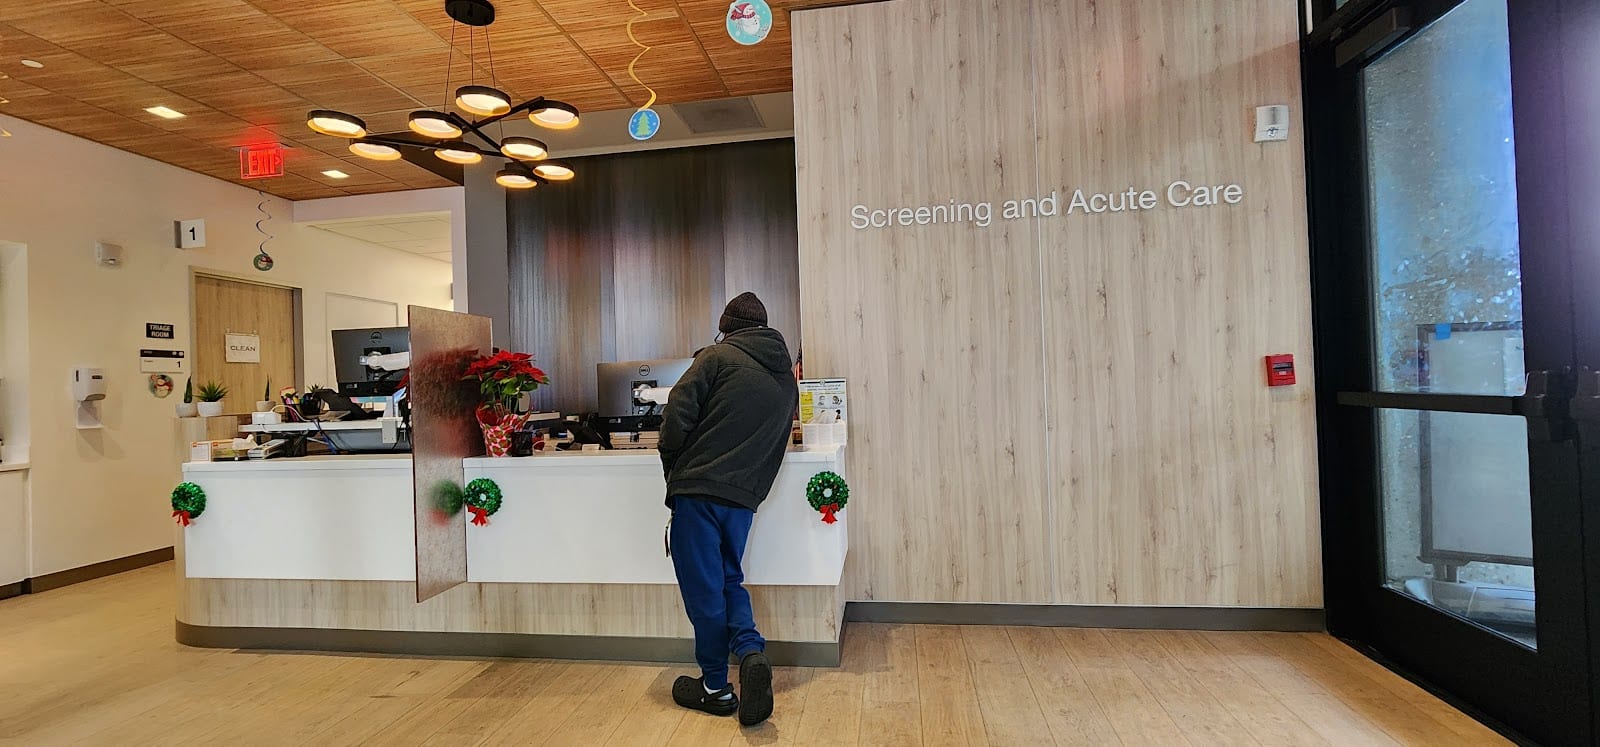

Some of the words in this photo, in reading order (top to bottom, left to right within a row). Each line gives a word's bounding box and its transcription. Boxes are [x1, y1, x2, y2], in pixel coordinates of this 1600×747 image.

[249, 149, 277, 175] EXIT
[850, 199, 992, 229] Screening
[1002, 191, 1057, 219] and
[1067, 186, 1157, 214] Acute
[1167, 180, 1243, 207] Care
[189, 226, 196, 241] 1
[149, 324, 172, 332] TRIAGE
[176, 361, 181, 369] 1
